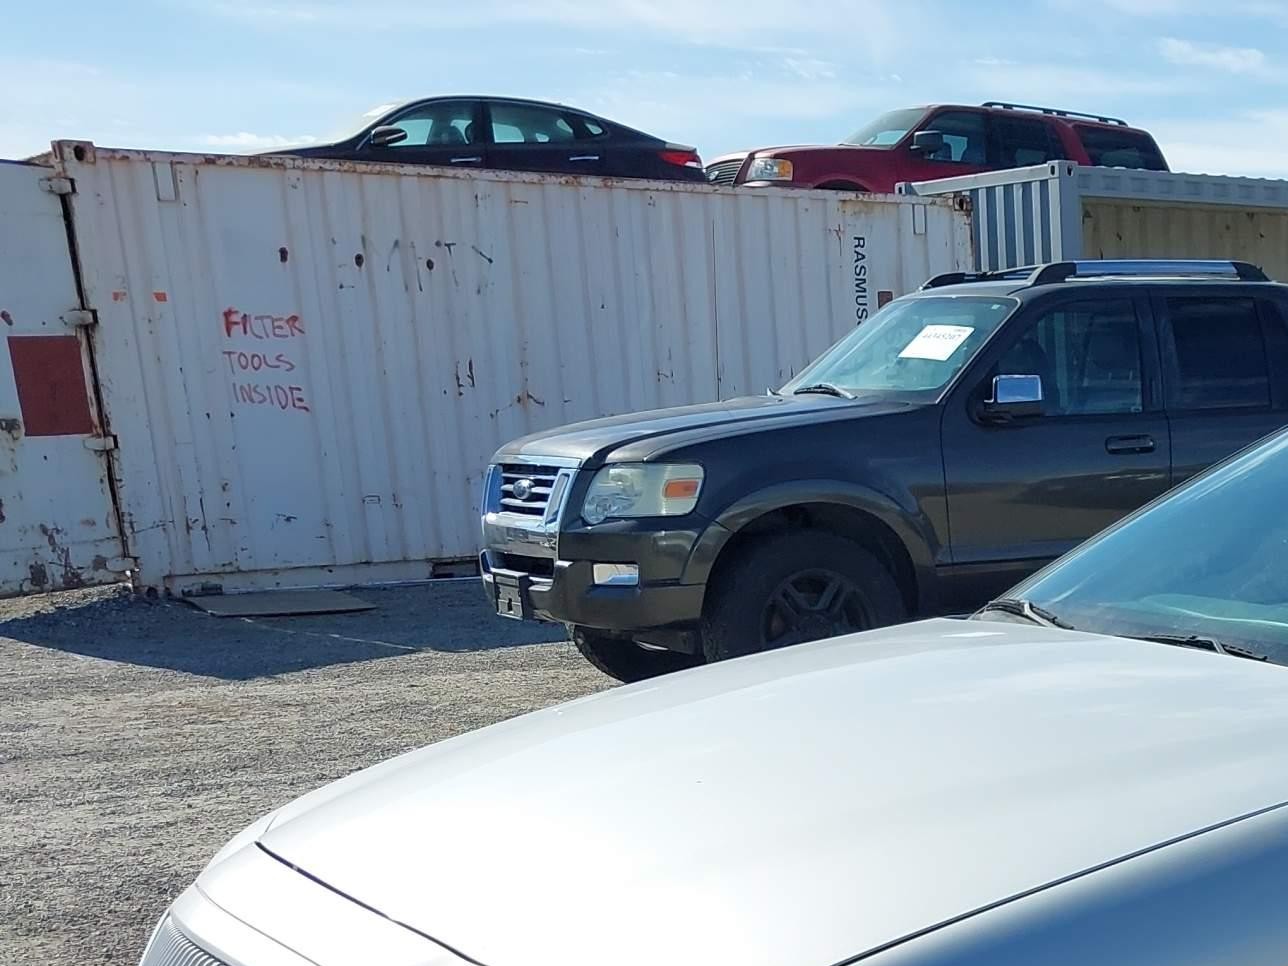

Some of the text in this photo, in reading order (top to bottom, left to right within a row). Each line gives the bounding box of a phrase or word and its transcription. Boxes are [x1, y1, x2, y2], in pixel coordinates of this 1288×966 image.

[223, 307, 306, 339] FILTER
[222, 350, 296, 375] TOOLS
[232, 382, 310, 412] INSIDE
